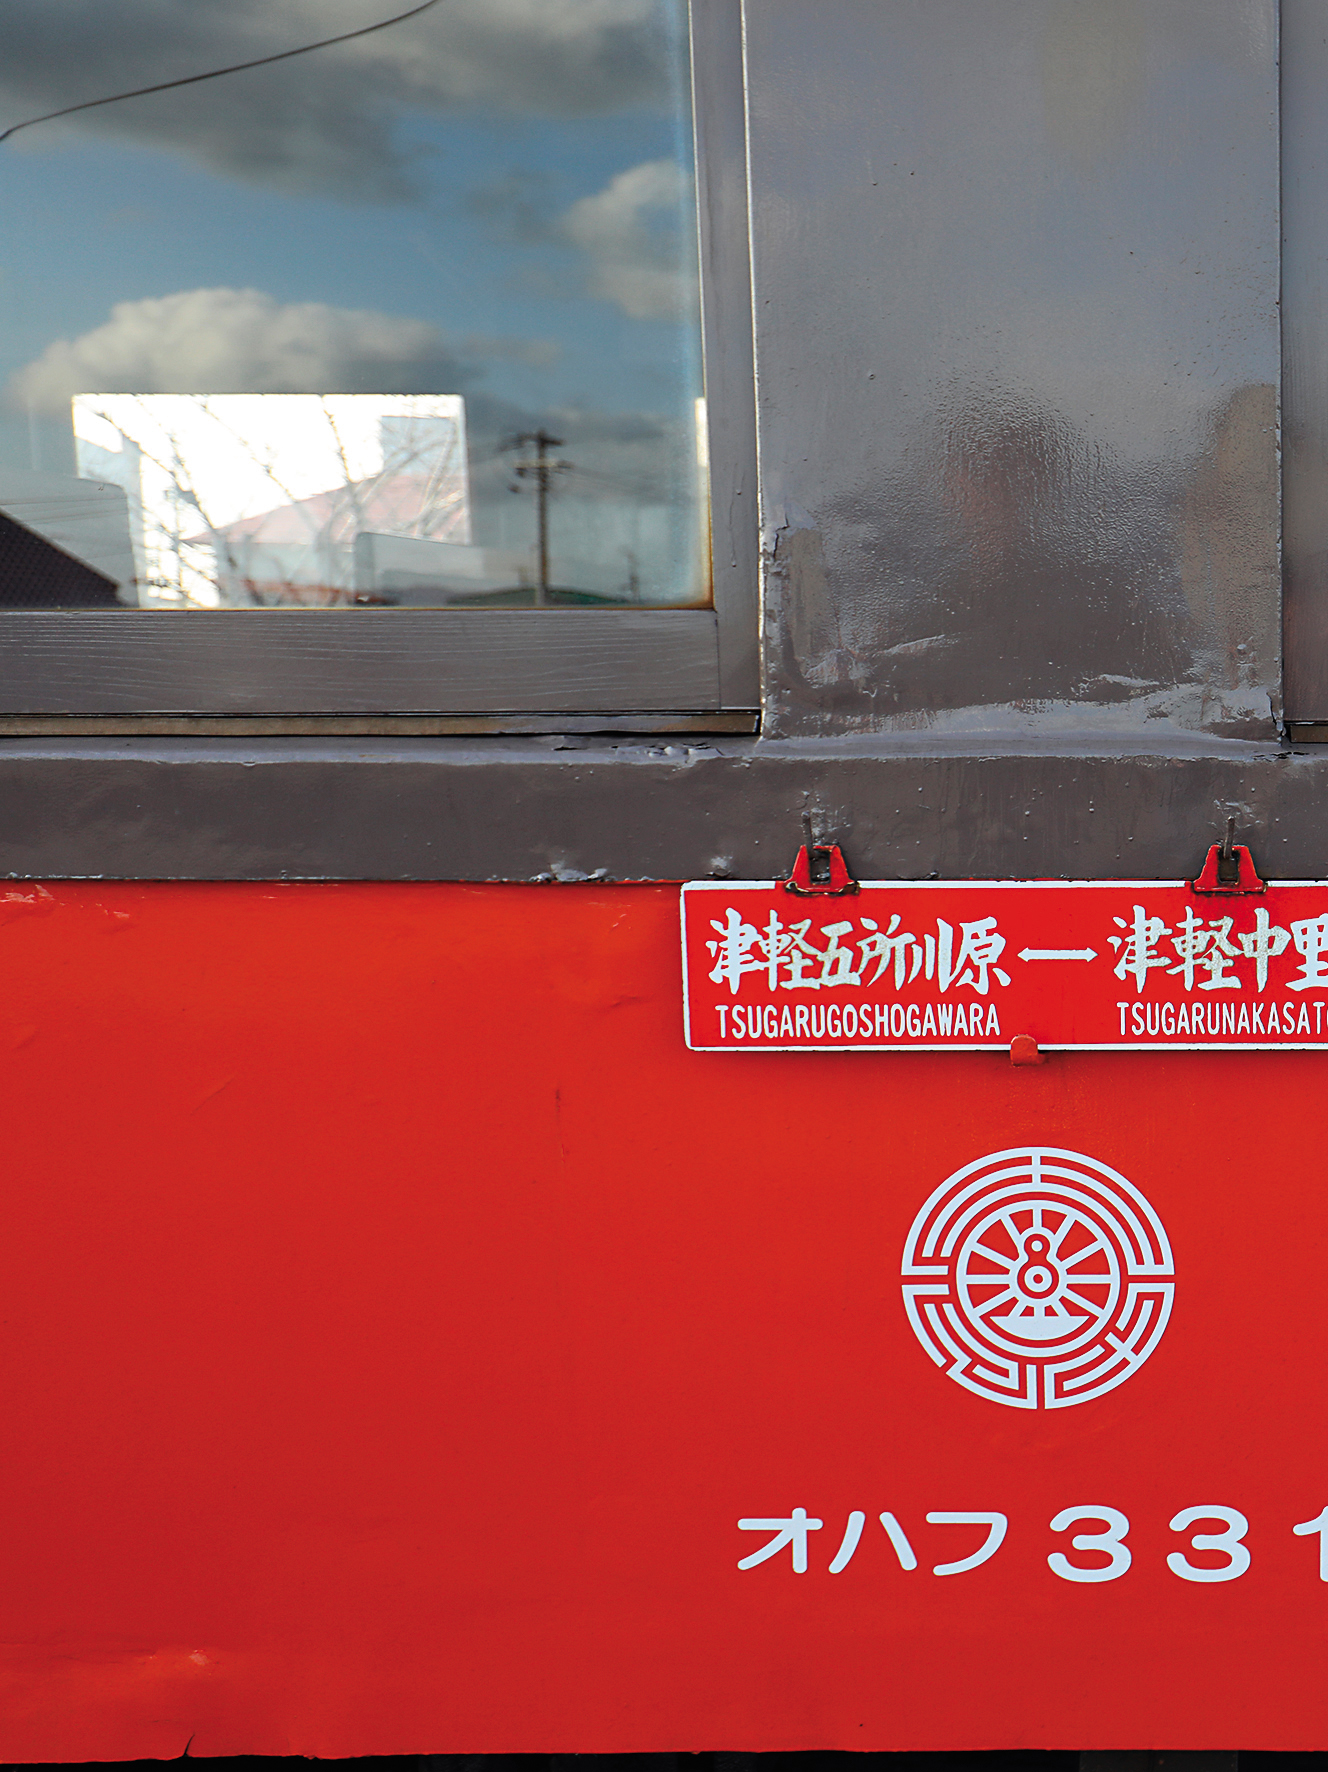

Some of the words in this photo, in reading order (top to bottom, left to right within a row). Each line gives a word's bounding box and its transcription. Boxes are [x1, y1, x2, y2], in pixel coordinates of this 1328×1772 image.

[705, 907, 1012, 996] 津軽五所川原
[714, 1002, 1001, 1040] TSUGARUGOSHOGAWARA
